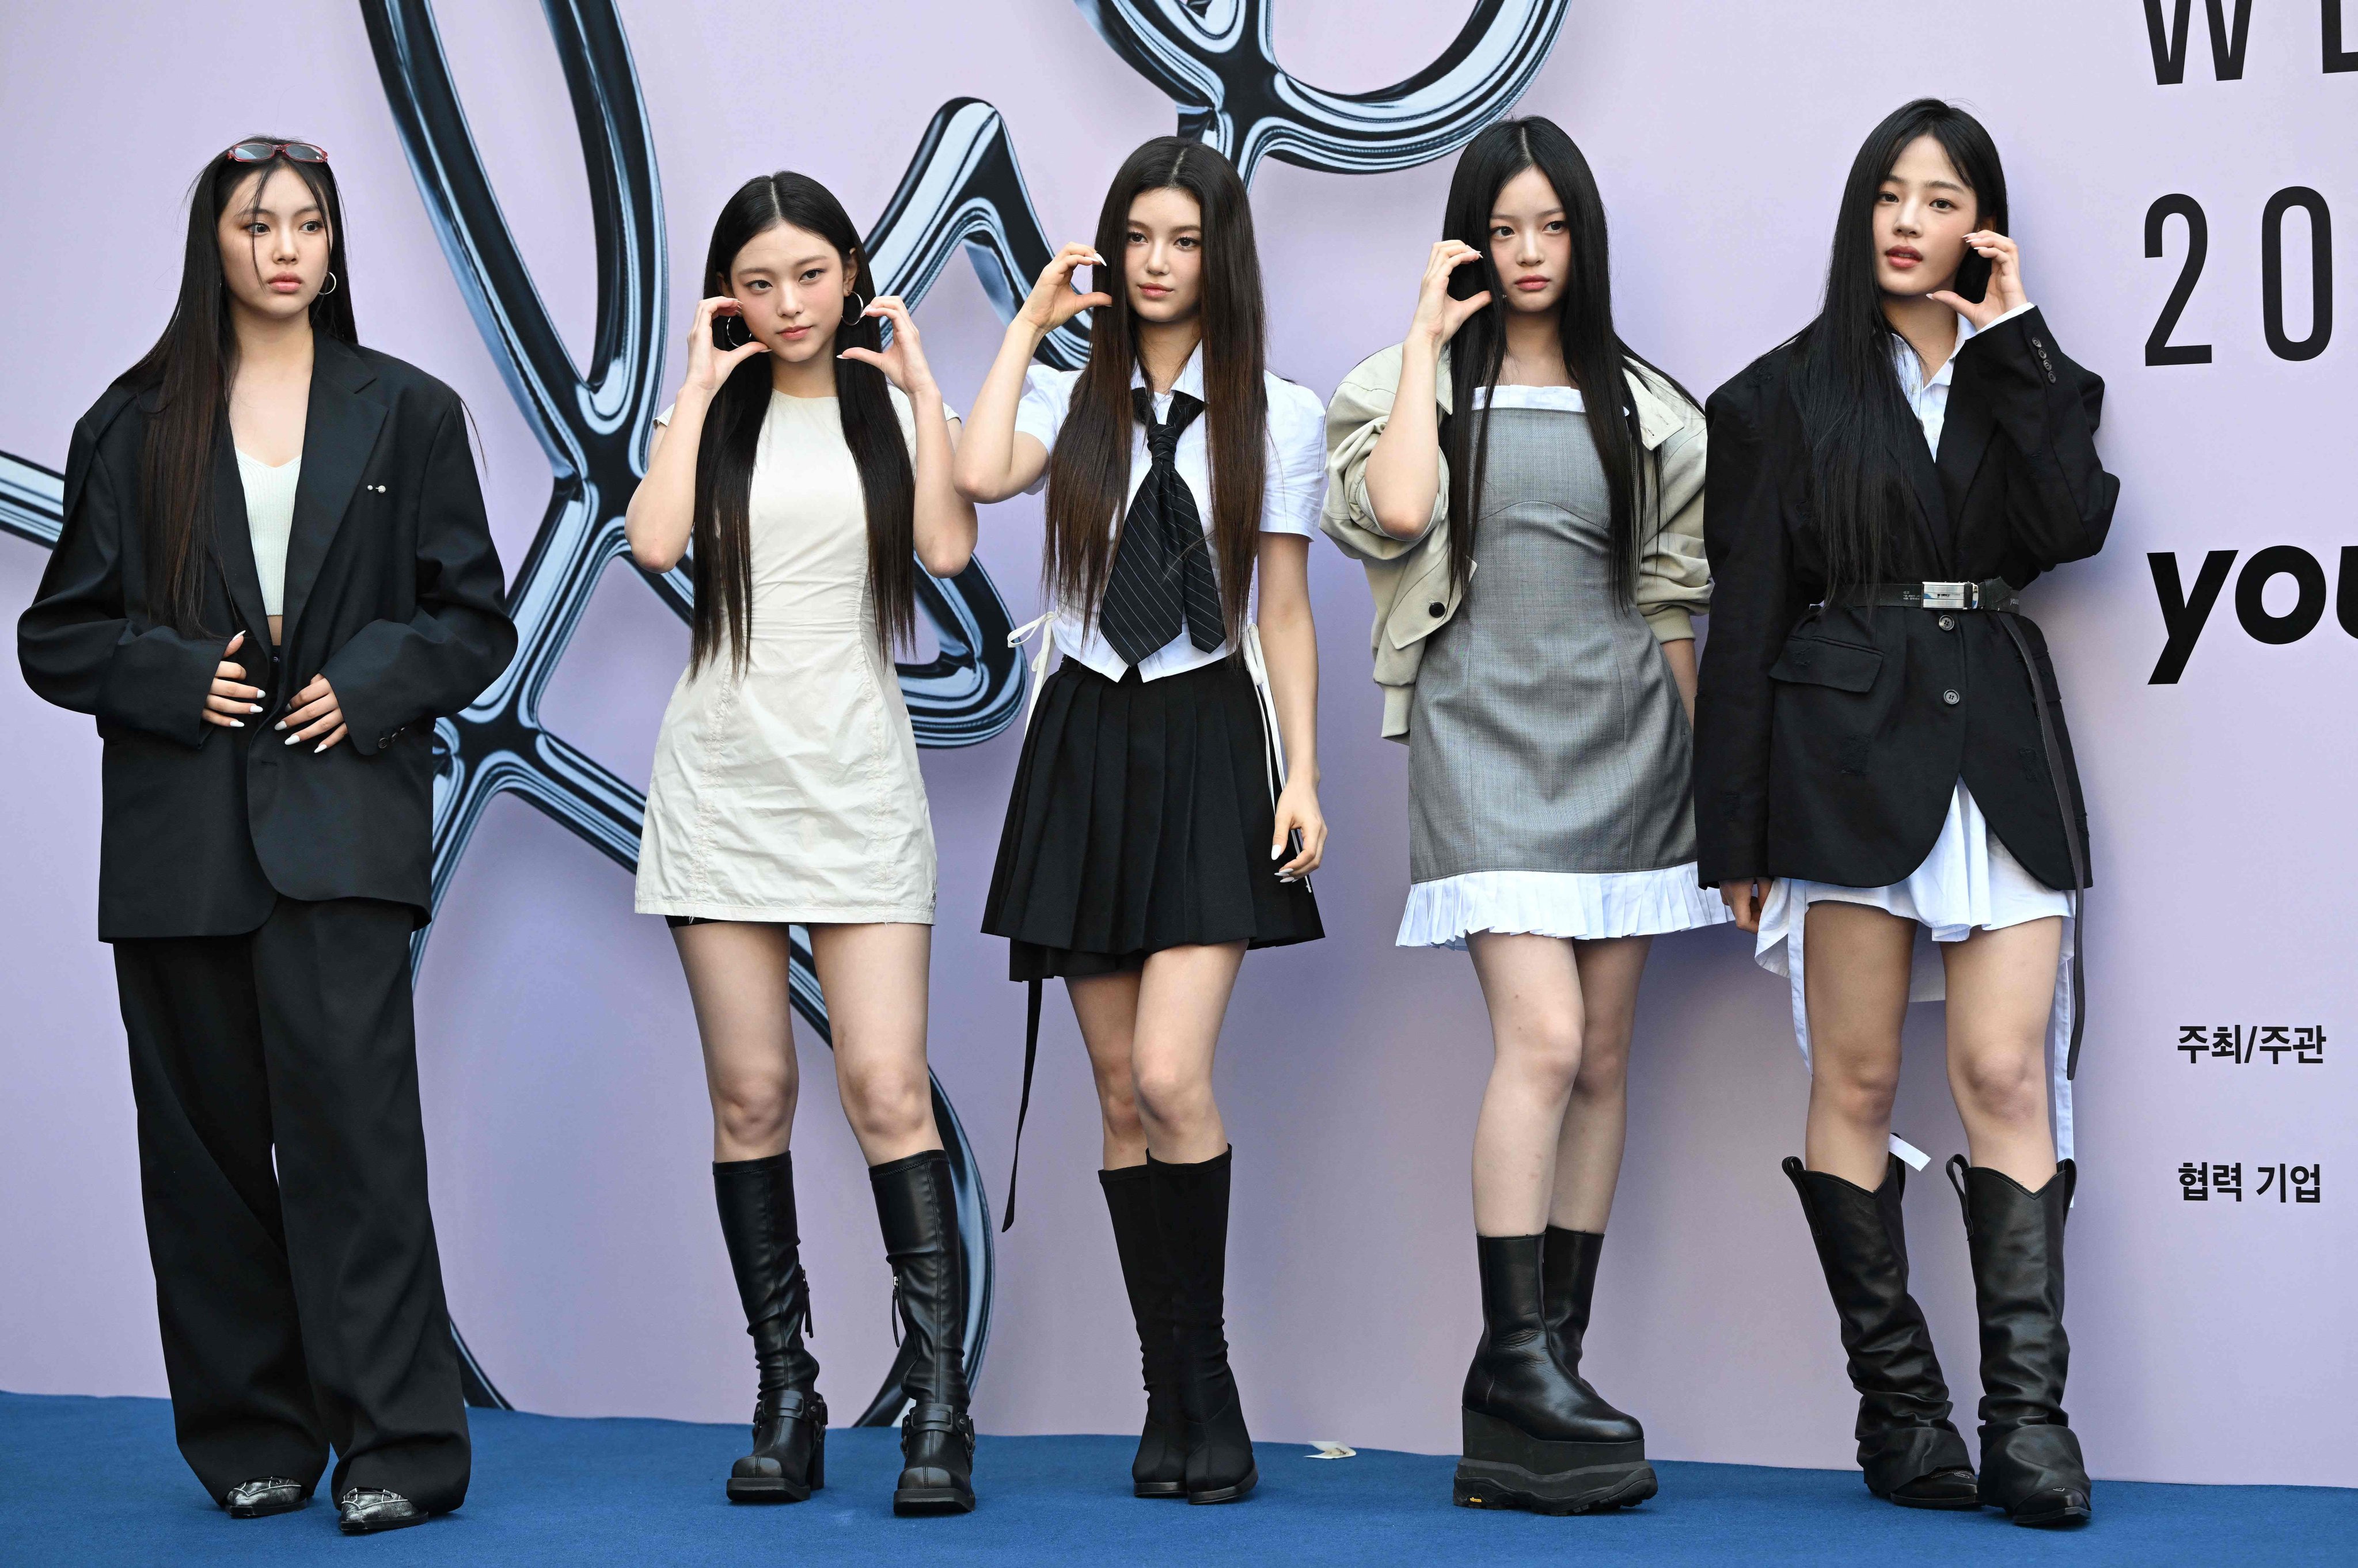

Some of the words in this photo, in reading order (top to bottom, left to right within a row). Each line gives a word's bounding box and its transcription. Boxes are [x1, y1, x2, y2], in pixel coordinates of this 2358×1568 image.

[2144, 186, 2333, 367] 20
[2146, 545, 2358, 685] yo
[2177, 1024, 2326, 1065] 주최/주관
[2178, 1161, 2242, 1202] 협력
[2256, 1163, 2321, 1203] 기업
